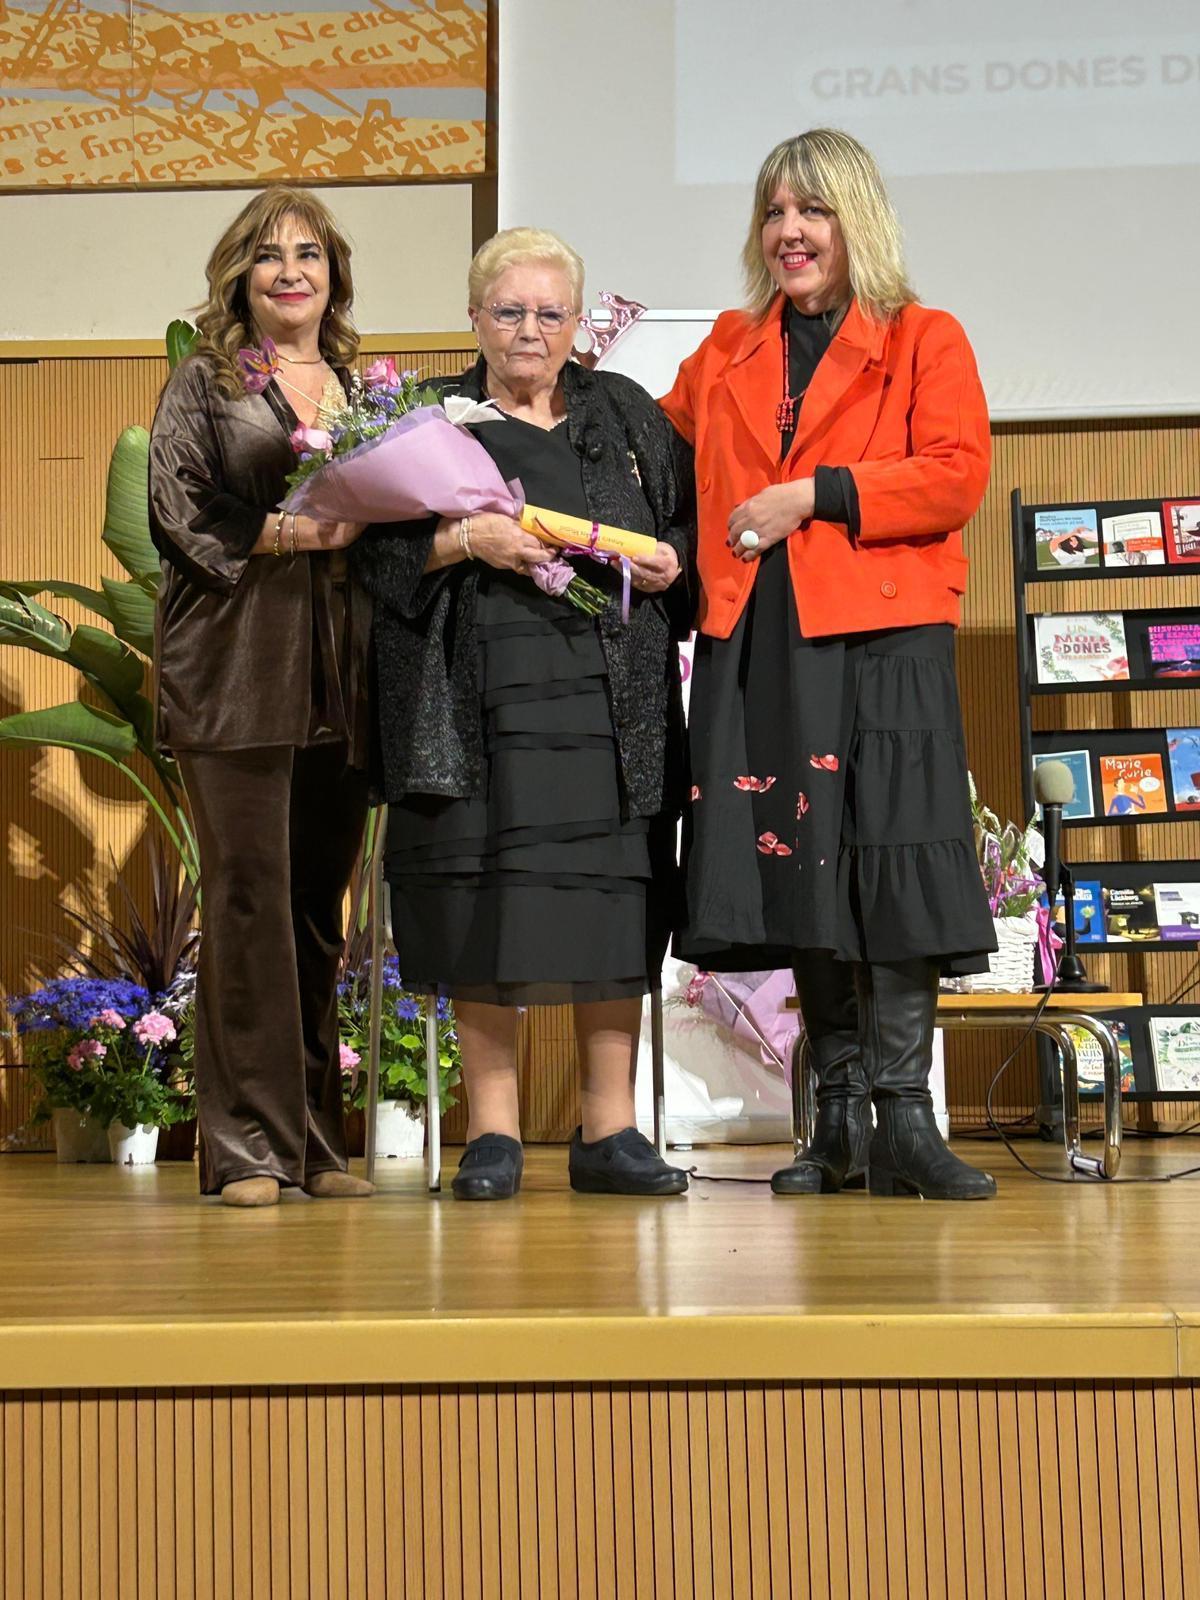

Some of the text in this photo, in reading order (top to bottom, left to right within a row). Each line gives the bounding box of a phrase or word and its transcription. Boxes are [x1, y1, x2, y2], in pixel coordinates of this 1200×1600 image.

[809, 64, 970, 100] GRANS
[985, 54, 1146, 93] DONES
[1063, 642, 1112, 654] DONES
[1105, 758, 1141, 770] Marie
[1119, 769, 1152, 779] Curie
